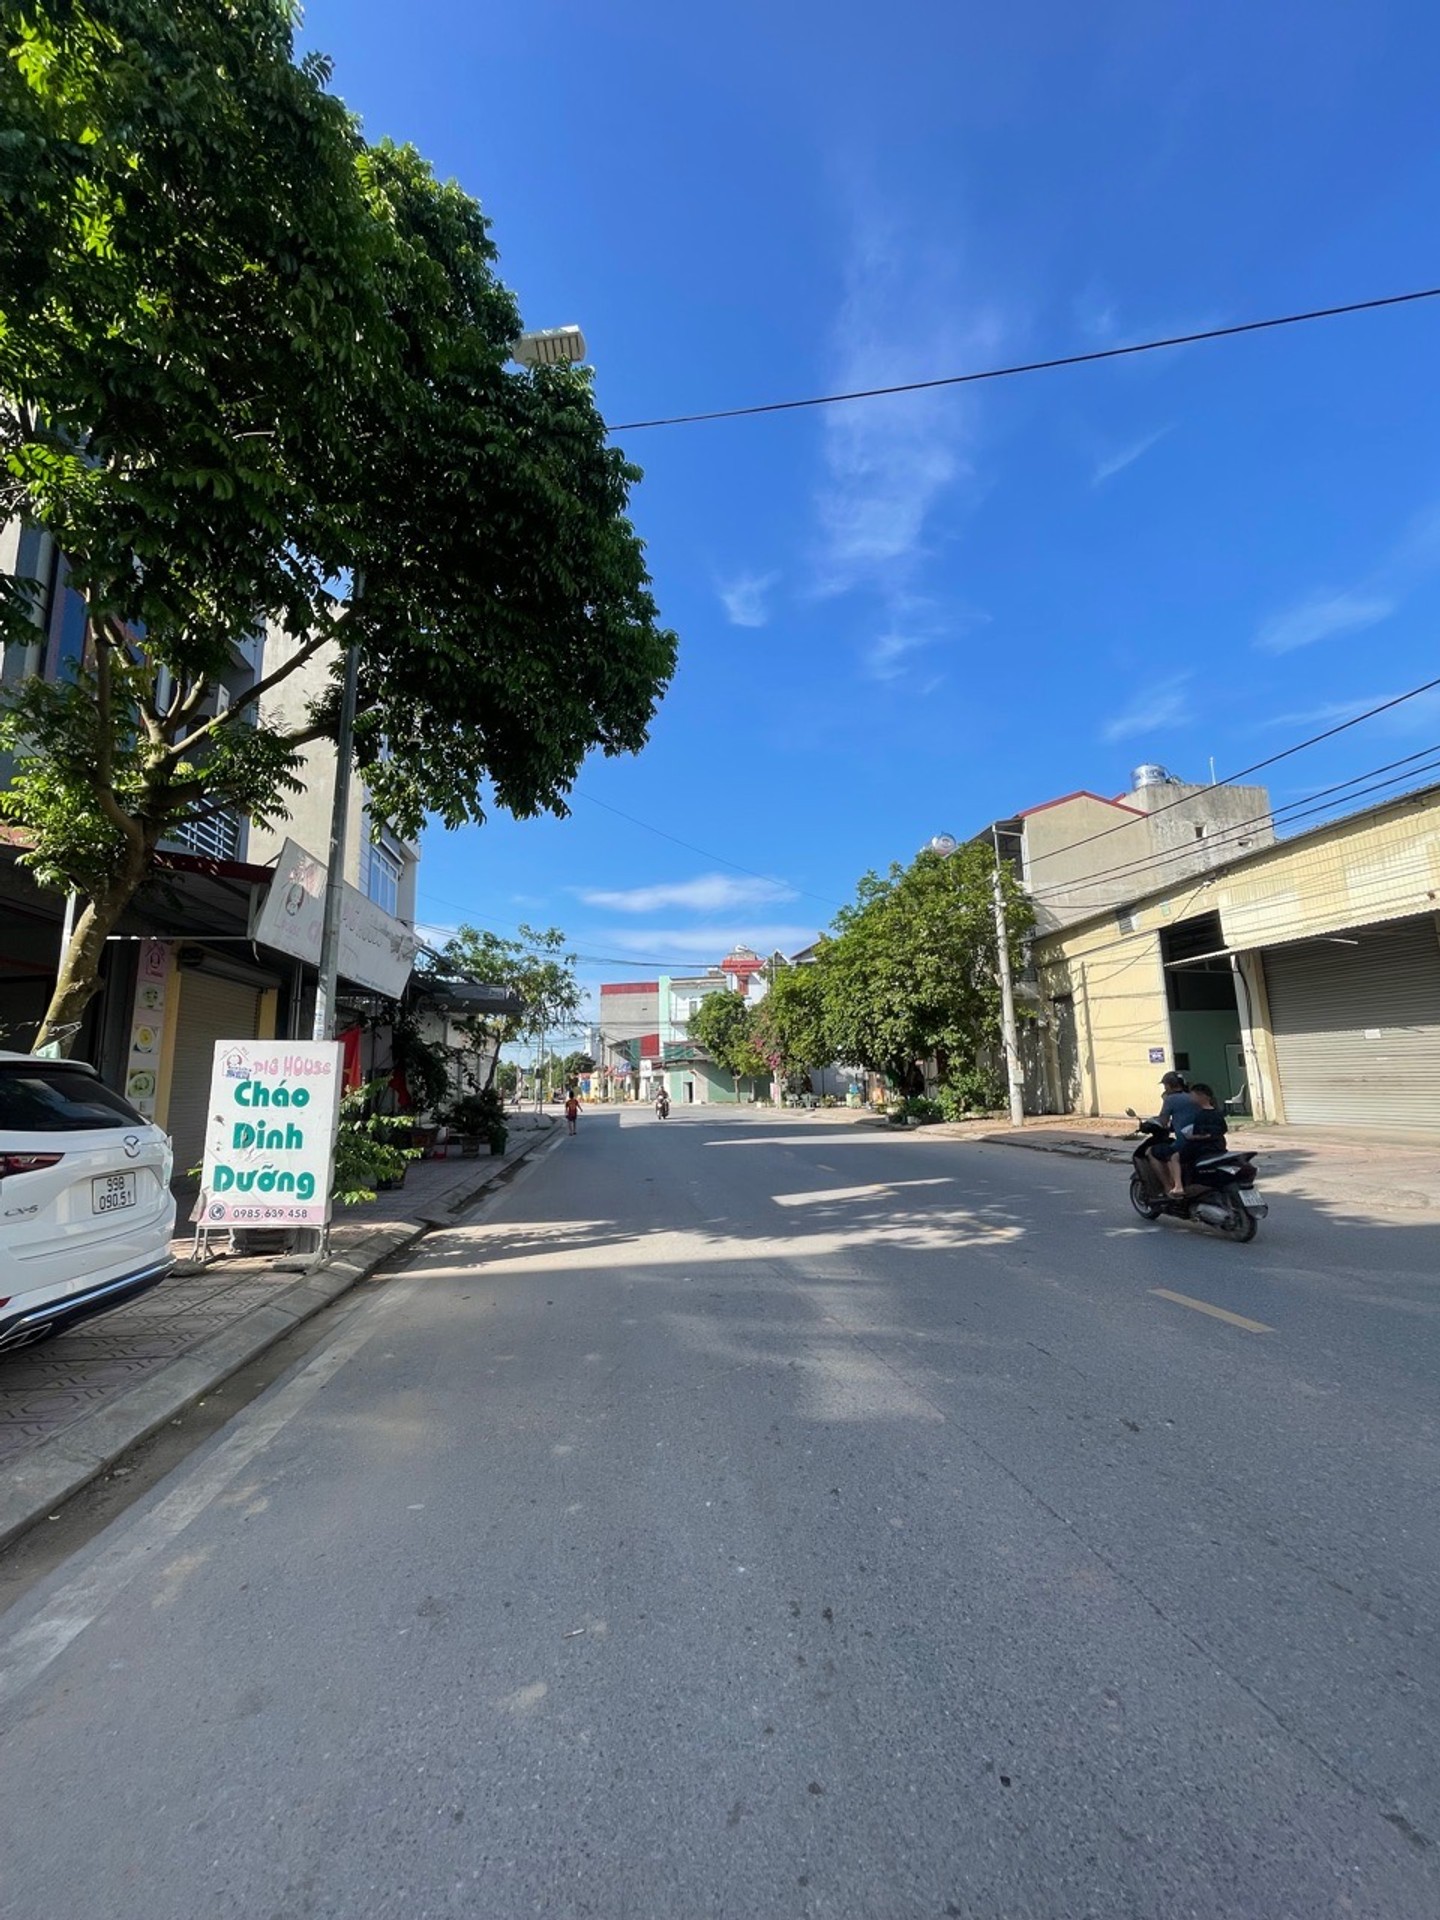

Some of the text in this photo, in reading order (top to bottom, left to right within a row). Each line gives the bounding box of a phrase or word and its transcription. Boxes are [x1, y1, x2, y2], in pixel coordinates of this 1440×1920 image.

[234, 1080, 310, 1107] Cháo
[233, 1121, 303, 1149] Dinh
[213, 1164, 315, 1200] Dưỡng
[232, 1208, 308, 1218] 0985.639.458
